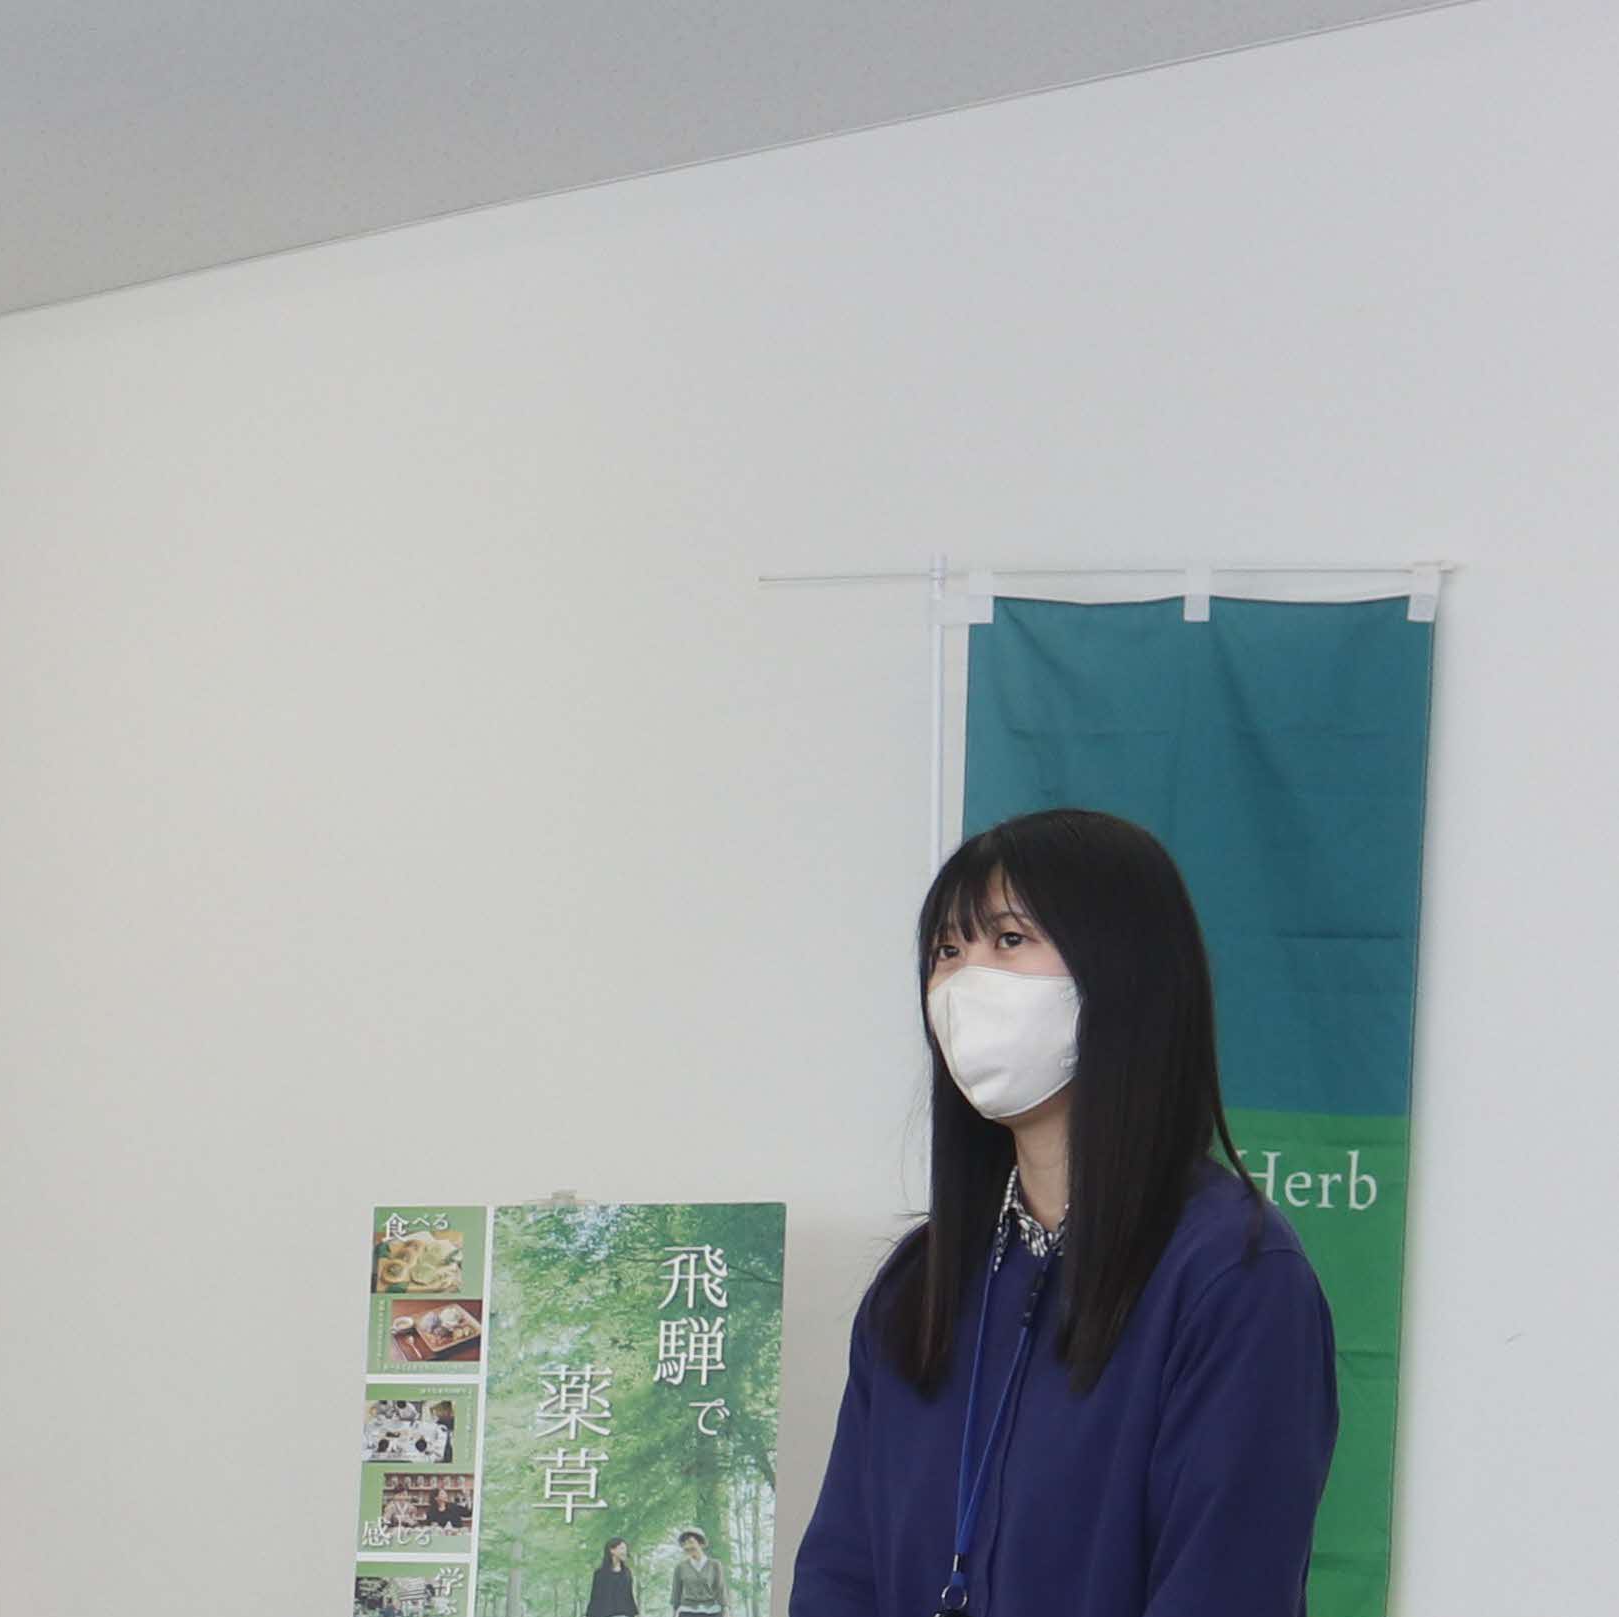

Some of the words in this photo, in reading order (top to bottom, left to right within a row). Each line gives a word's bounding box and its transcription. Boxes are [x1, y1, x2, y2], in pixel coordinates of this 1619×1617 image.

[1233, 1149, 1378, 1210] Herb
[382, 1211, 450, 1241] 食べる
[651, 1243, 731, 1437] 飛騨で
[532, 1363, 613, 1524] 薬草
[361, 1516, 431, 1547] 感じる
[434, 1566, 465, 1617] 学ぶ
